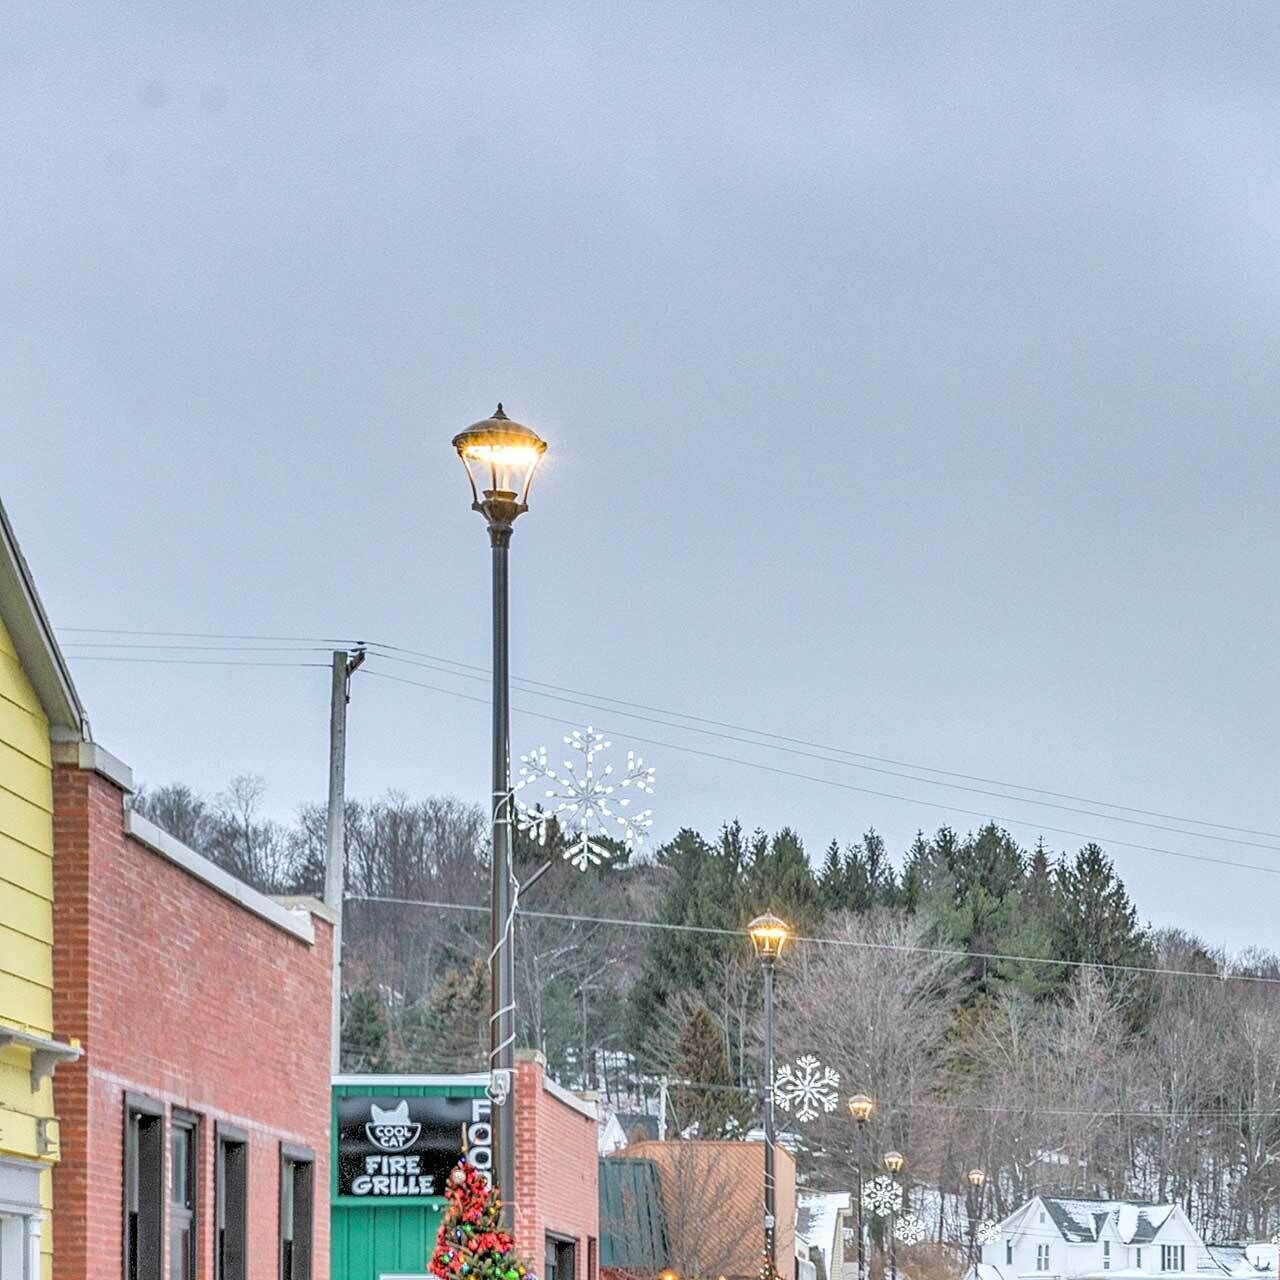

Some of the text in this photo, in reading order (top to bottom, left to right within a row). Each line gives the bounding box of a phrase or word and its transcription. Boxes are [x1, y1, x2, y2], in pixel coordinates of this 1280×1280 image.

[375, 1126, 412, 1137] COOL
[380, 1137, 406, 1147] CAT
[365, 1155, 420, 1175] FIRE
[351, 1174, 435, 1195] GRILLE
